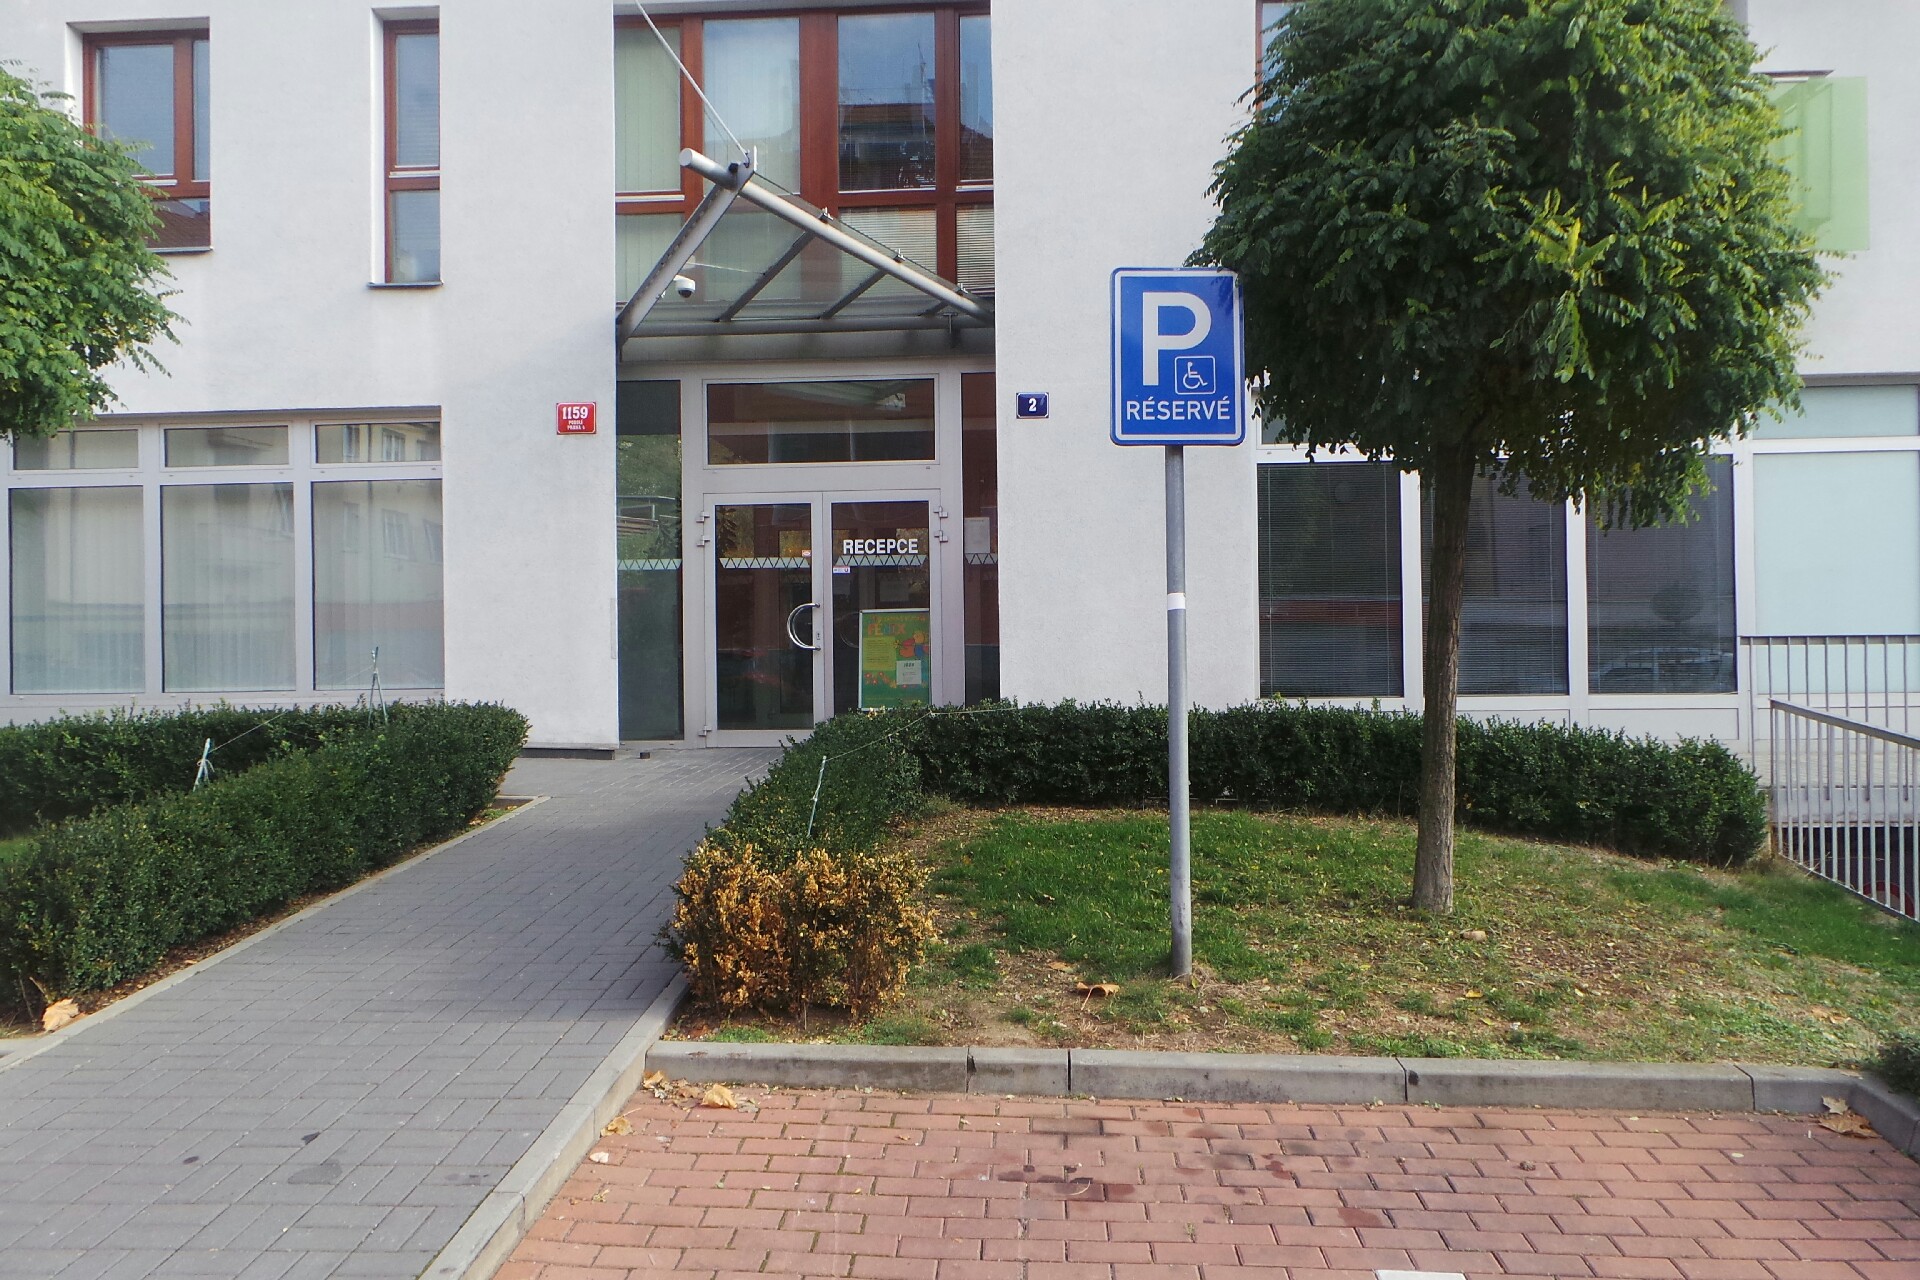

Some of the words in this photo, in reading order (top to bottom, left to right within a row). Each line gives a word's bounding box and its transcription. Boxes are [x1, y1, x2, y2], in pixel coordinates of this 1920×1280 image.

[1143, 291, 1212, 386] P
[562, 406, 588, 419] 1159
[1028, 397, 1037, 412] 2
[1126, 395, 1231, 421] RÉSERVÉ
[843, 538, 919, 555] RECEPCE
